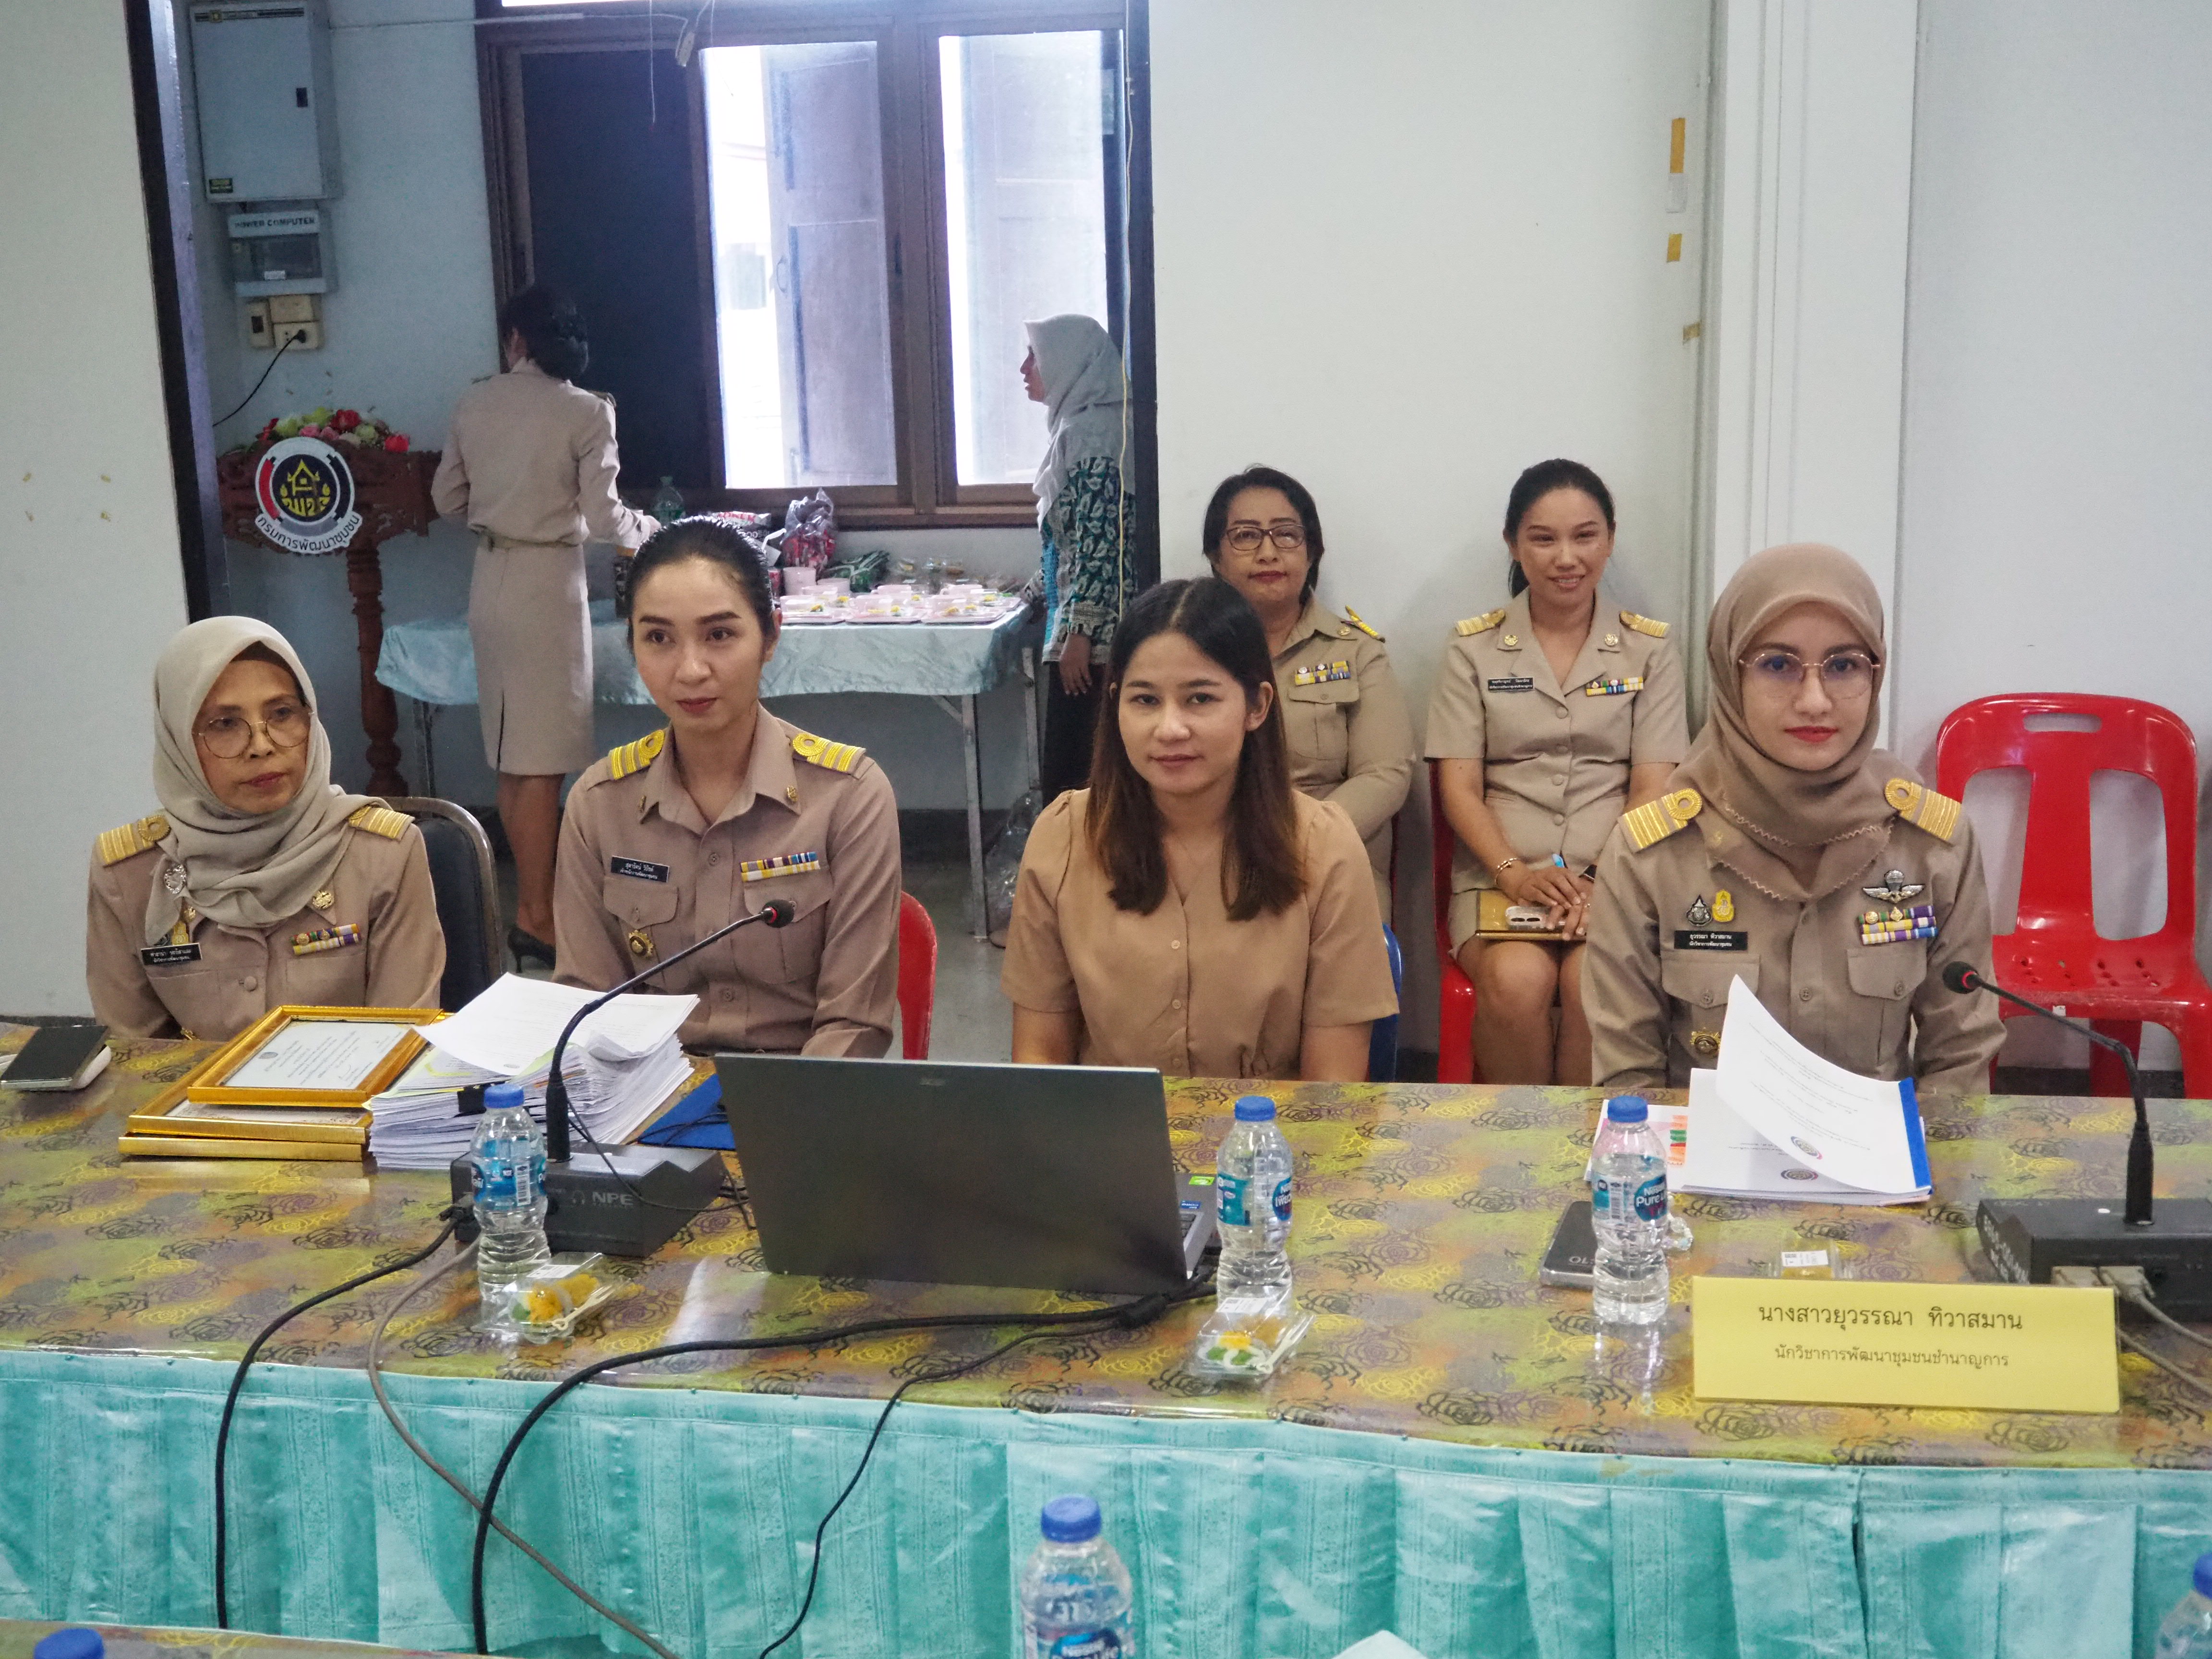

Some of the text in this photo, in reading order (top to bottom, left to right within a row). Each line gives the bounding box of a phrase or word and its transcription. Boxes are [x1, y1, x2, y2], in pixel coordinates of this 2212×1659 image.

[267, 217, 315, 227] COMPUTER
[257, 515, 360, 551] กรมการพัฒนาชุมชน
[592, 1192, 634, 1205] NPE
[1759, 1306, 2023, 1331] นางสาวยุวรรณา ทิวาสมาน
[1775, 1344, 2009, 1370] นักวิชาการพัฒนาชุมชนชำนาญการ
